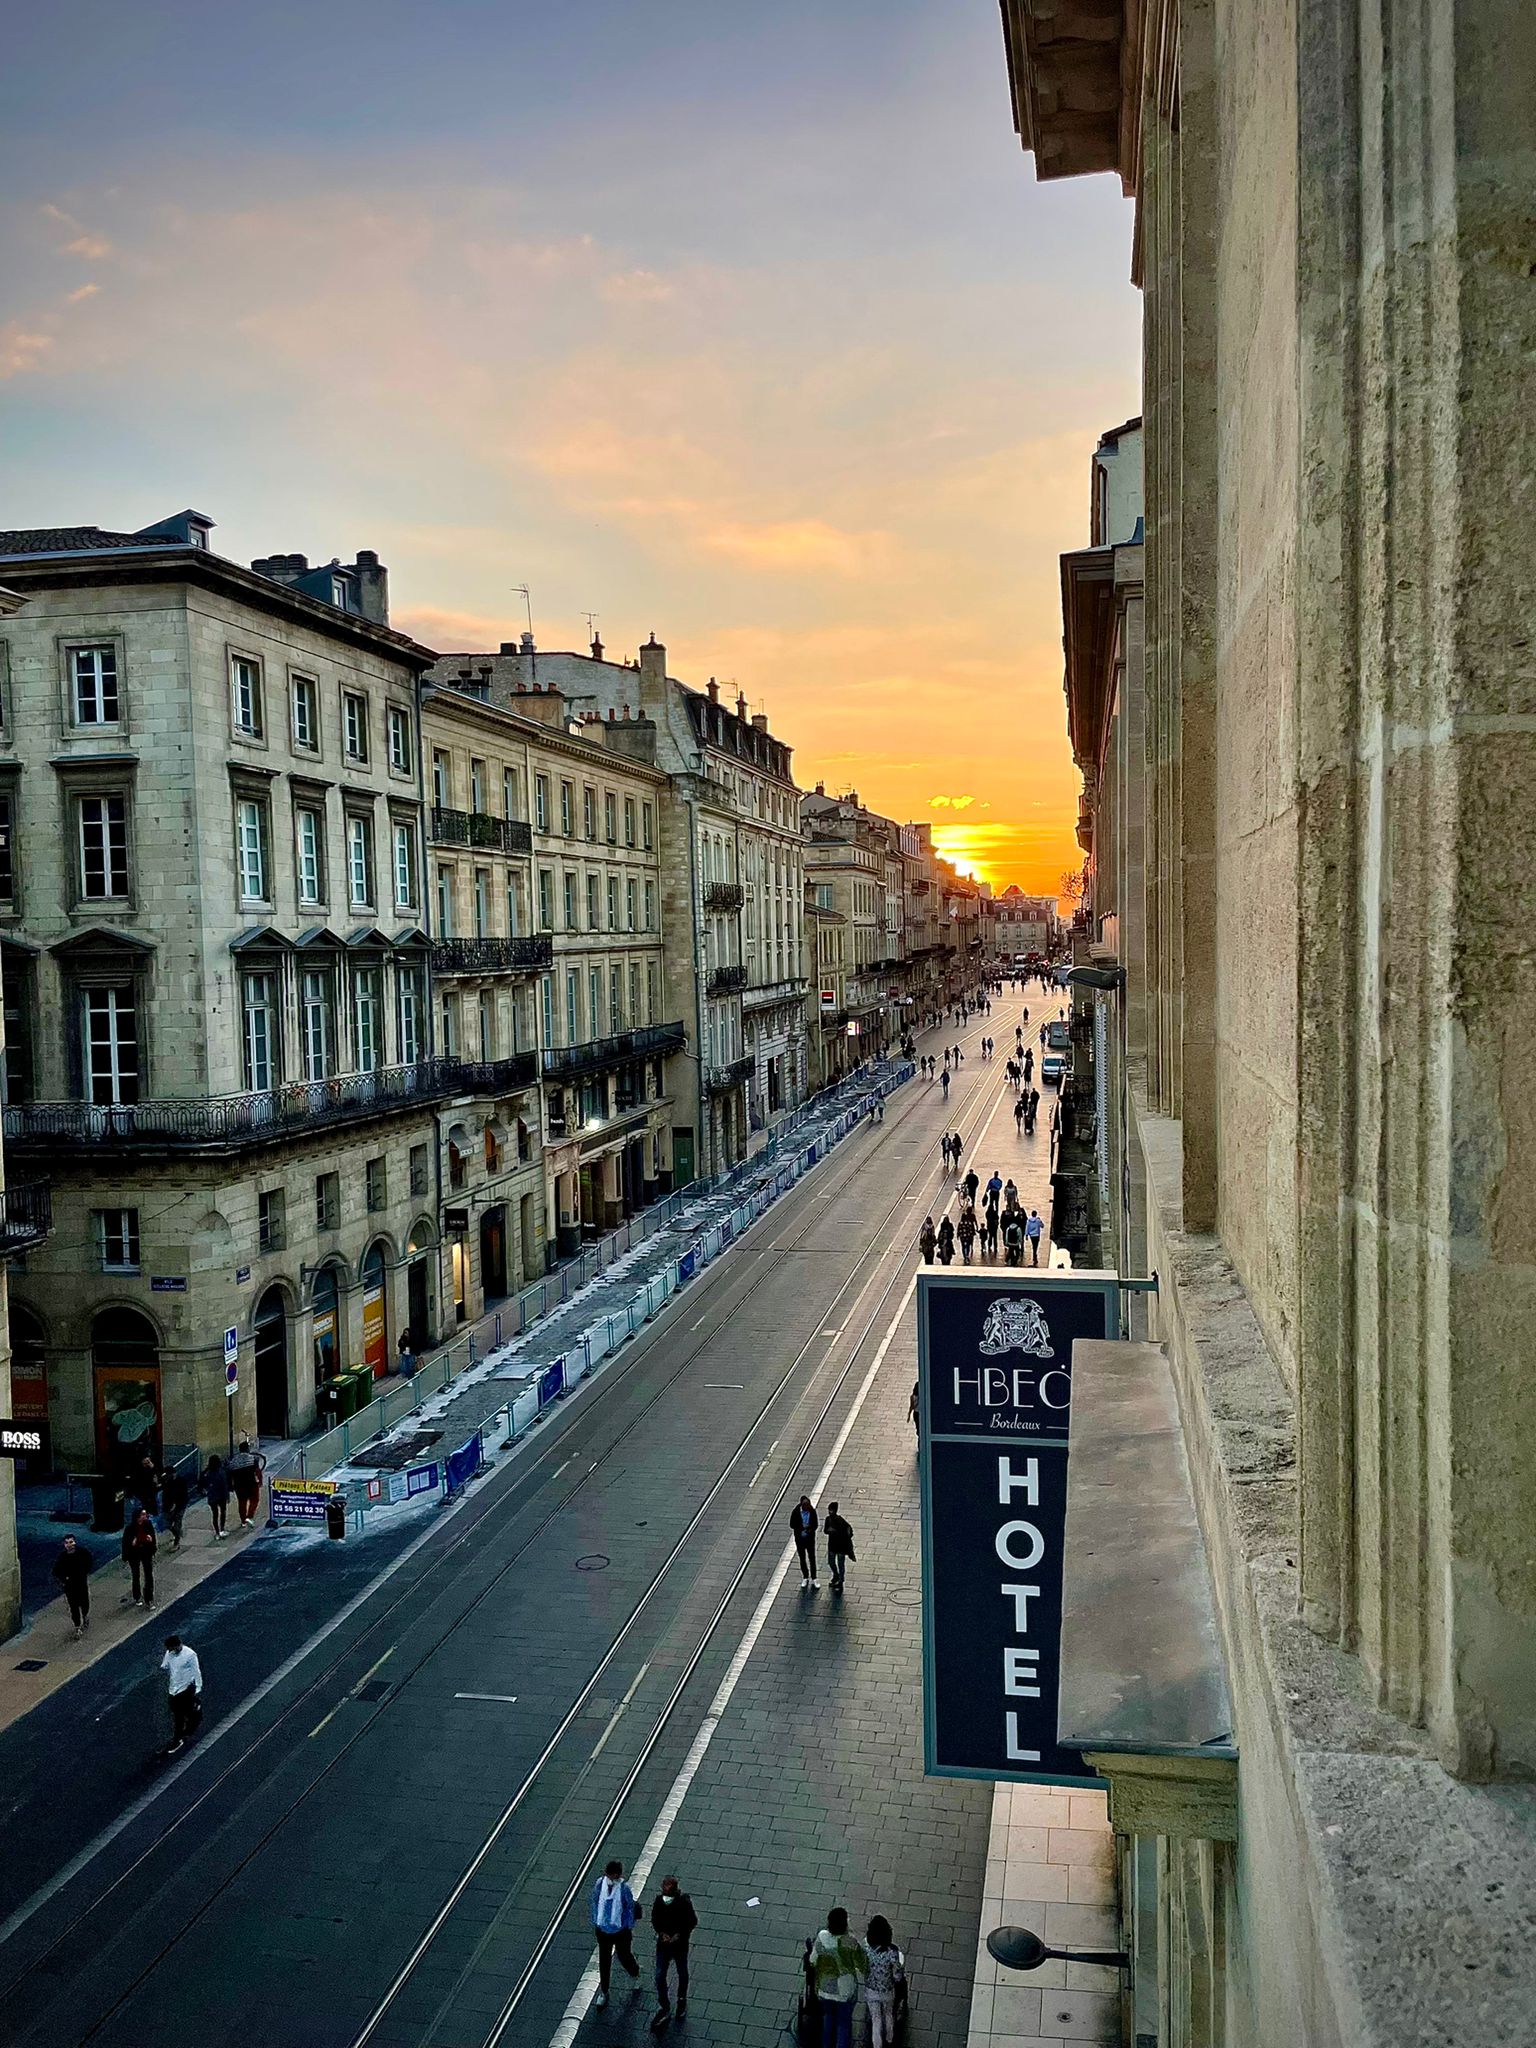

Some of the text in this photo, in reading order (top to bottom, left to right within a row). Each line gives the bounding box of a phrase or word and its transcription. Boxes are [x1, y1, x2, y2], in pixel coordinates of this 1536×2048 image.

[990, 1412, 1041, 1430] Bordeaux
[1, 1431, 41, 1446] BOSS
[995, 1456, 1045, 1762] HOTEL
